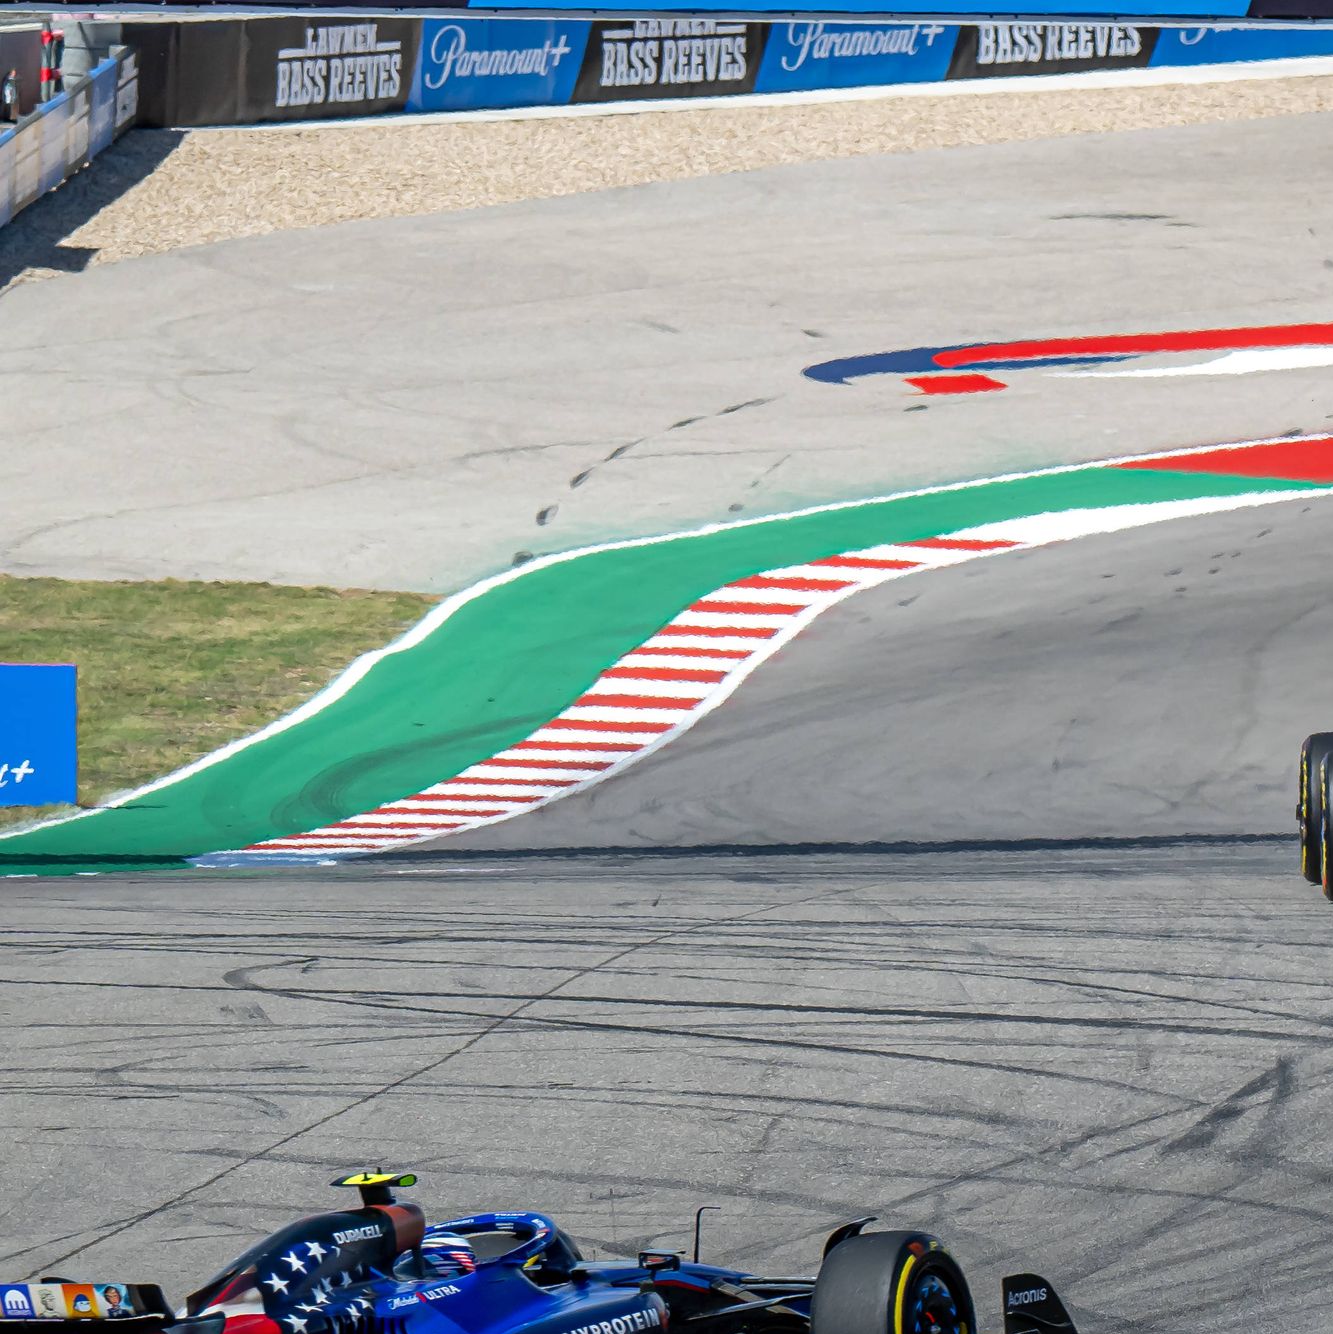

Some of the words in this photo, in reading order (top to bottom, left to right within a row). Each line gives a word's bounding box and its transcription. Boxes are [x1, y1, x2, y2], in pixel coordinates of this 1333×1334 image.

[425, 24, 571, 90] Paramount+
[601, 41, 659, 86] BASS
[660, 36, 747, 84] REEVES
[781, 22, 945, 71] Paramount+
[977, 26, 1041, 64] BASS
[1046, 26, 1142, 59] REEVES
[276, 59, 326, 107] BASS
[328, 53, 401, 103] REEVES
[423, 1285, 461, 1300] ULTRA
[1008, 1288, 1047, 1307] Acronis
